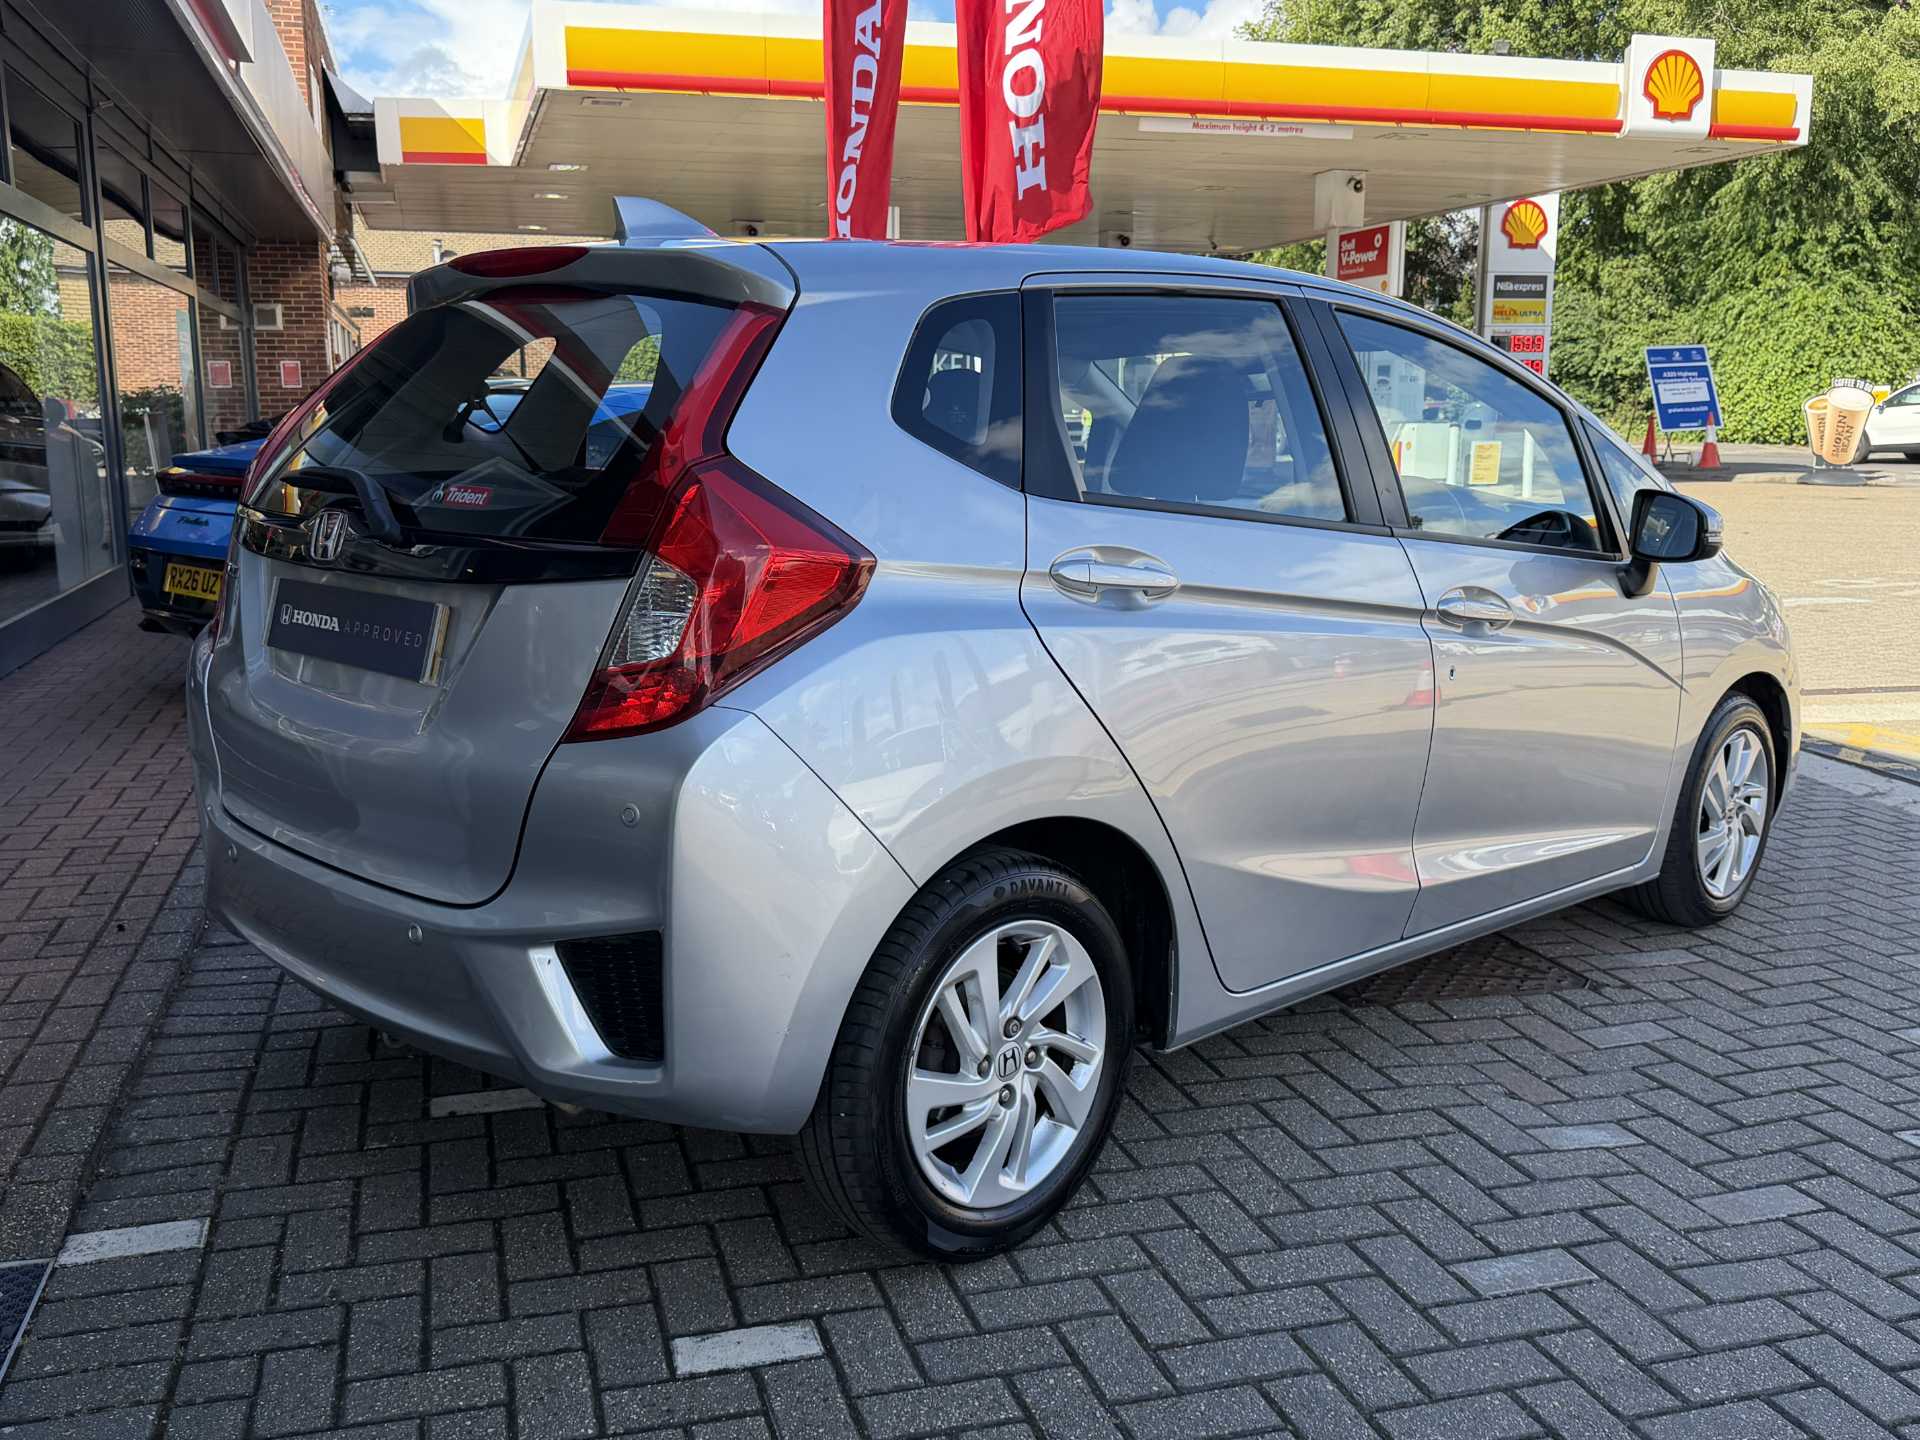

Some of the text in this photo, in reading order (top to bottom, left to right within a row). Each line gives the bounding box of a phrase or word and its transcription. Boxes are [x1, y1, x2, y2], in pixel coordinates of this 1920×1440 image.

[1192, 121, 1231, 131] Maximum
[1233, 122, 1257, 133] height
[1341, 238, 1356, 251] Shell
[1341, 250, 1379, 266] V-Power
[446, 487, 489, 505] Trident
[168, 565, 224, 595] RX26 UZ
[291, 609, 423, 648] HONDA APPROVED
[1010, 878, 1069, 897] DAVANTI
